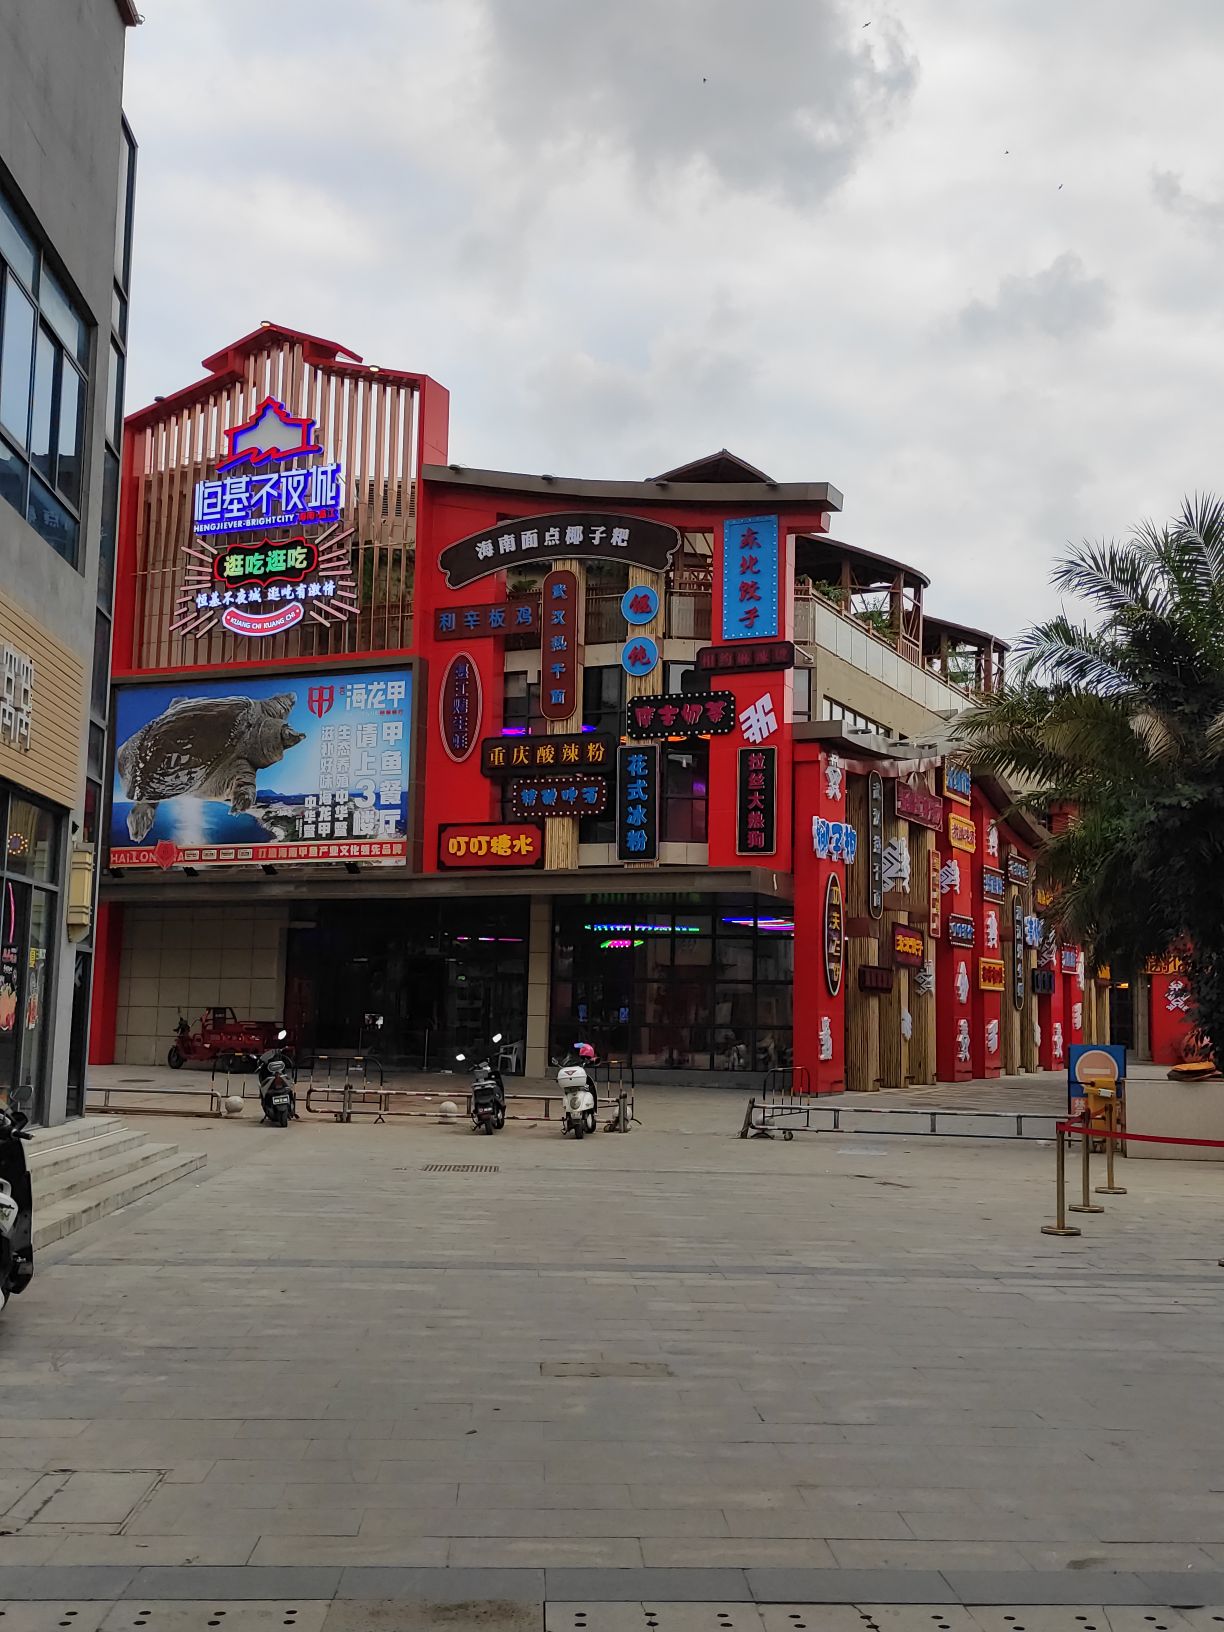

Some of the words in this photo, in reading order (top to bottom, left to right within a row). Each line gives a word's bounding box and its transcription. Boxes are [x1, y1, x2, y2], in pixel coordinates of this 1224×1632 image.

[194, 466, 344, 521] 恒基不夜城
[223, 546, 308, 578] 逛吃逛吃
[475, 525, 631, 561] 海南面点椰子粑
[196, 587, 262, 609] 恒基不夜城
[739, 527, 762, 629] 东北饺子
[439, 606, 532, 632] 利辛板鸡
[551, 583, 568, 706] 武汉热干面
[353, 722, 377, 837] 请上3楼
[379, 722, 403, 835] 甲鱼餐厅
[489, 743, 606, 767] 重庆酸辣粉
[627, 754, 648, 852] 花式冰粉
[747, 752, 766, 848] 拉丝大热狗
[448, 834, 534, 856] 叮叮糖水
